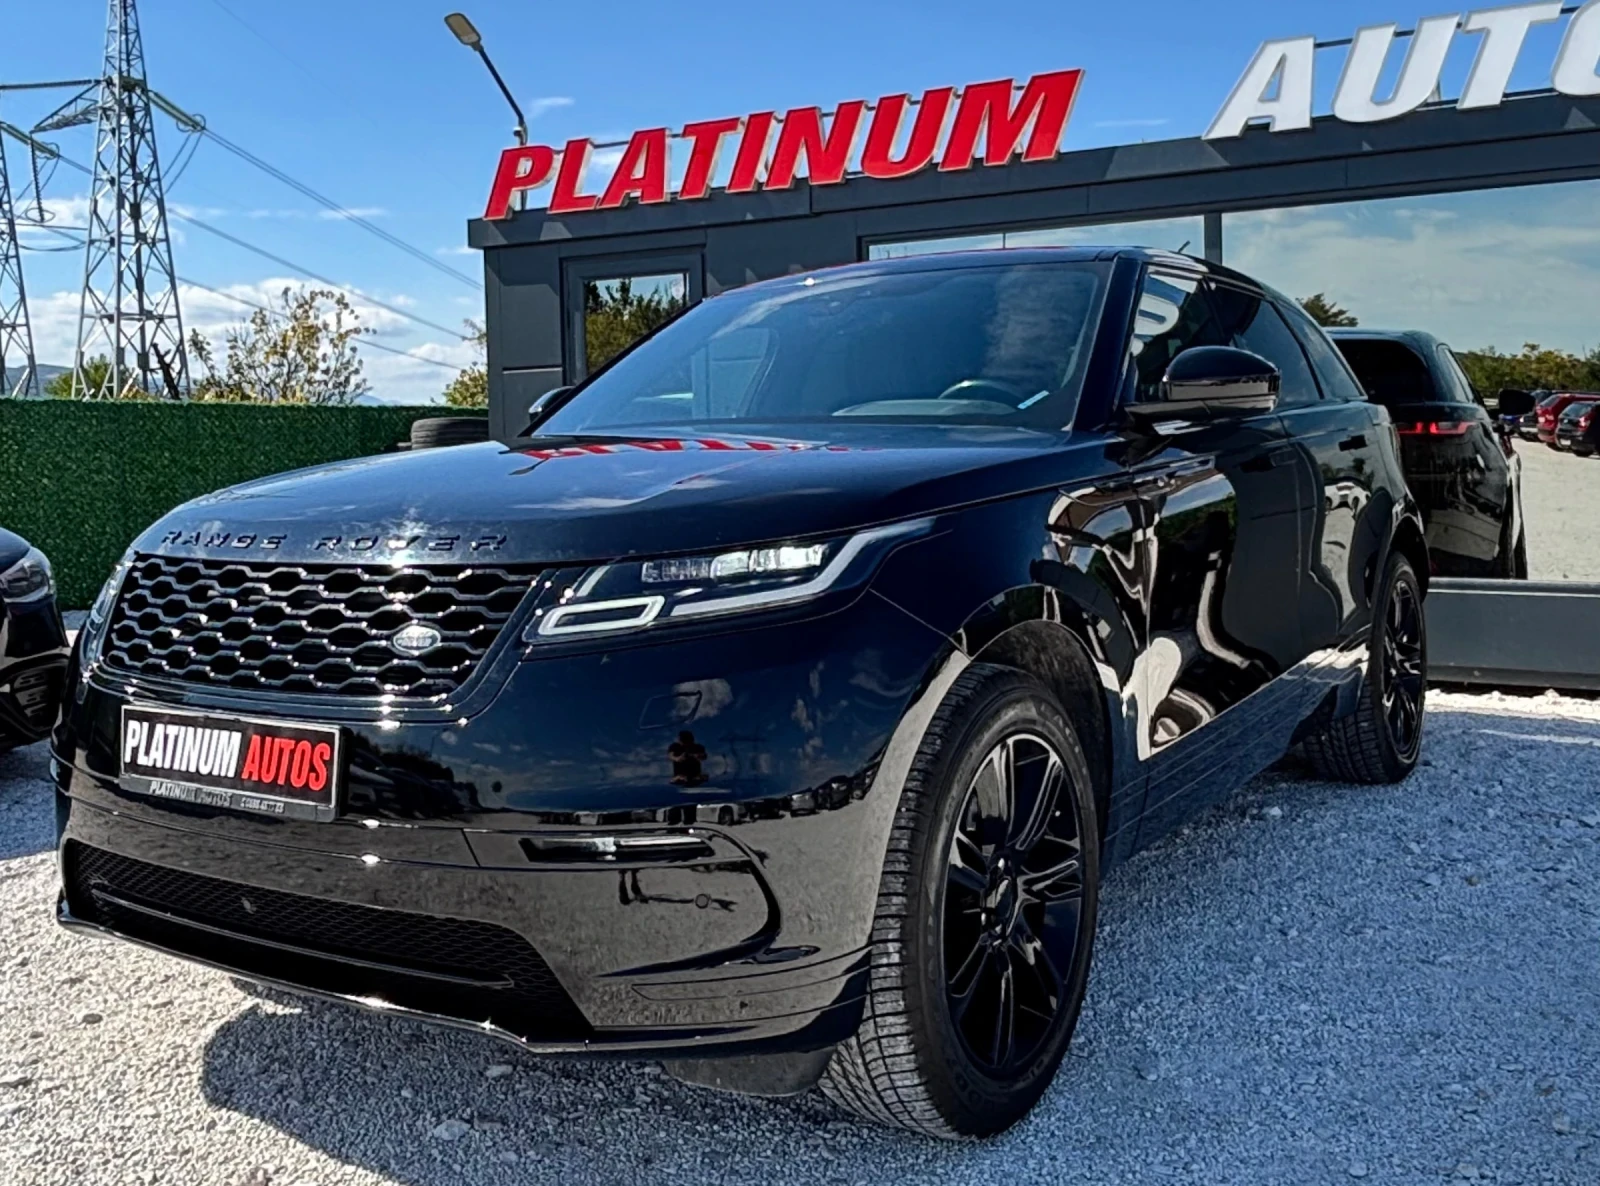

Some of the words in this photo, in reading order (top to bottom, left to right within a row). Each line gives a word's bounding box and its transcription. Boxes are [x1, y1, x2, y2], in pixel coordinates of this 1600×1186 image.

[483, 69, 1085, 221] PLATINUM
[161, 530, 287, 549] RANGE
[312, 535, 507, 551] ROVER
[124, 720, 242, 778] PLATINUM
[241, 734, 331, 791] AUTOS
